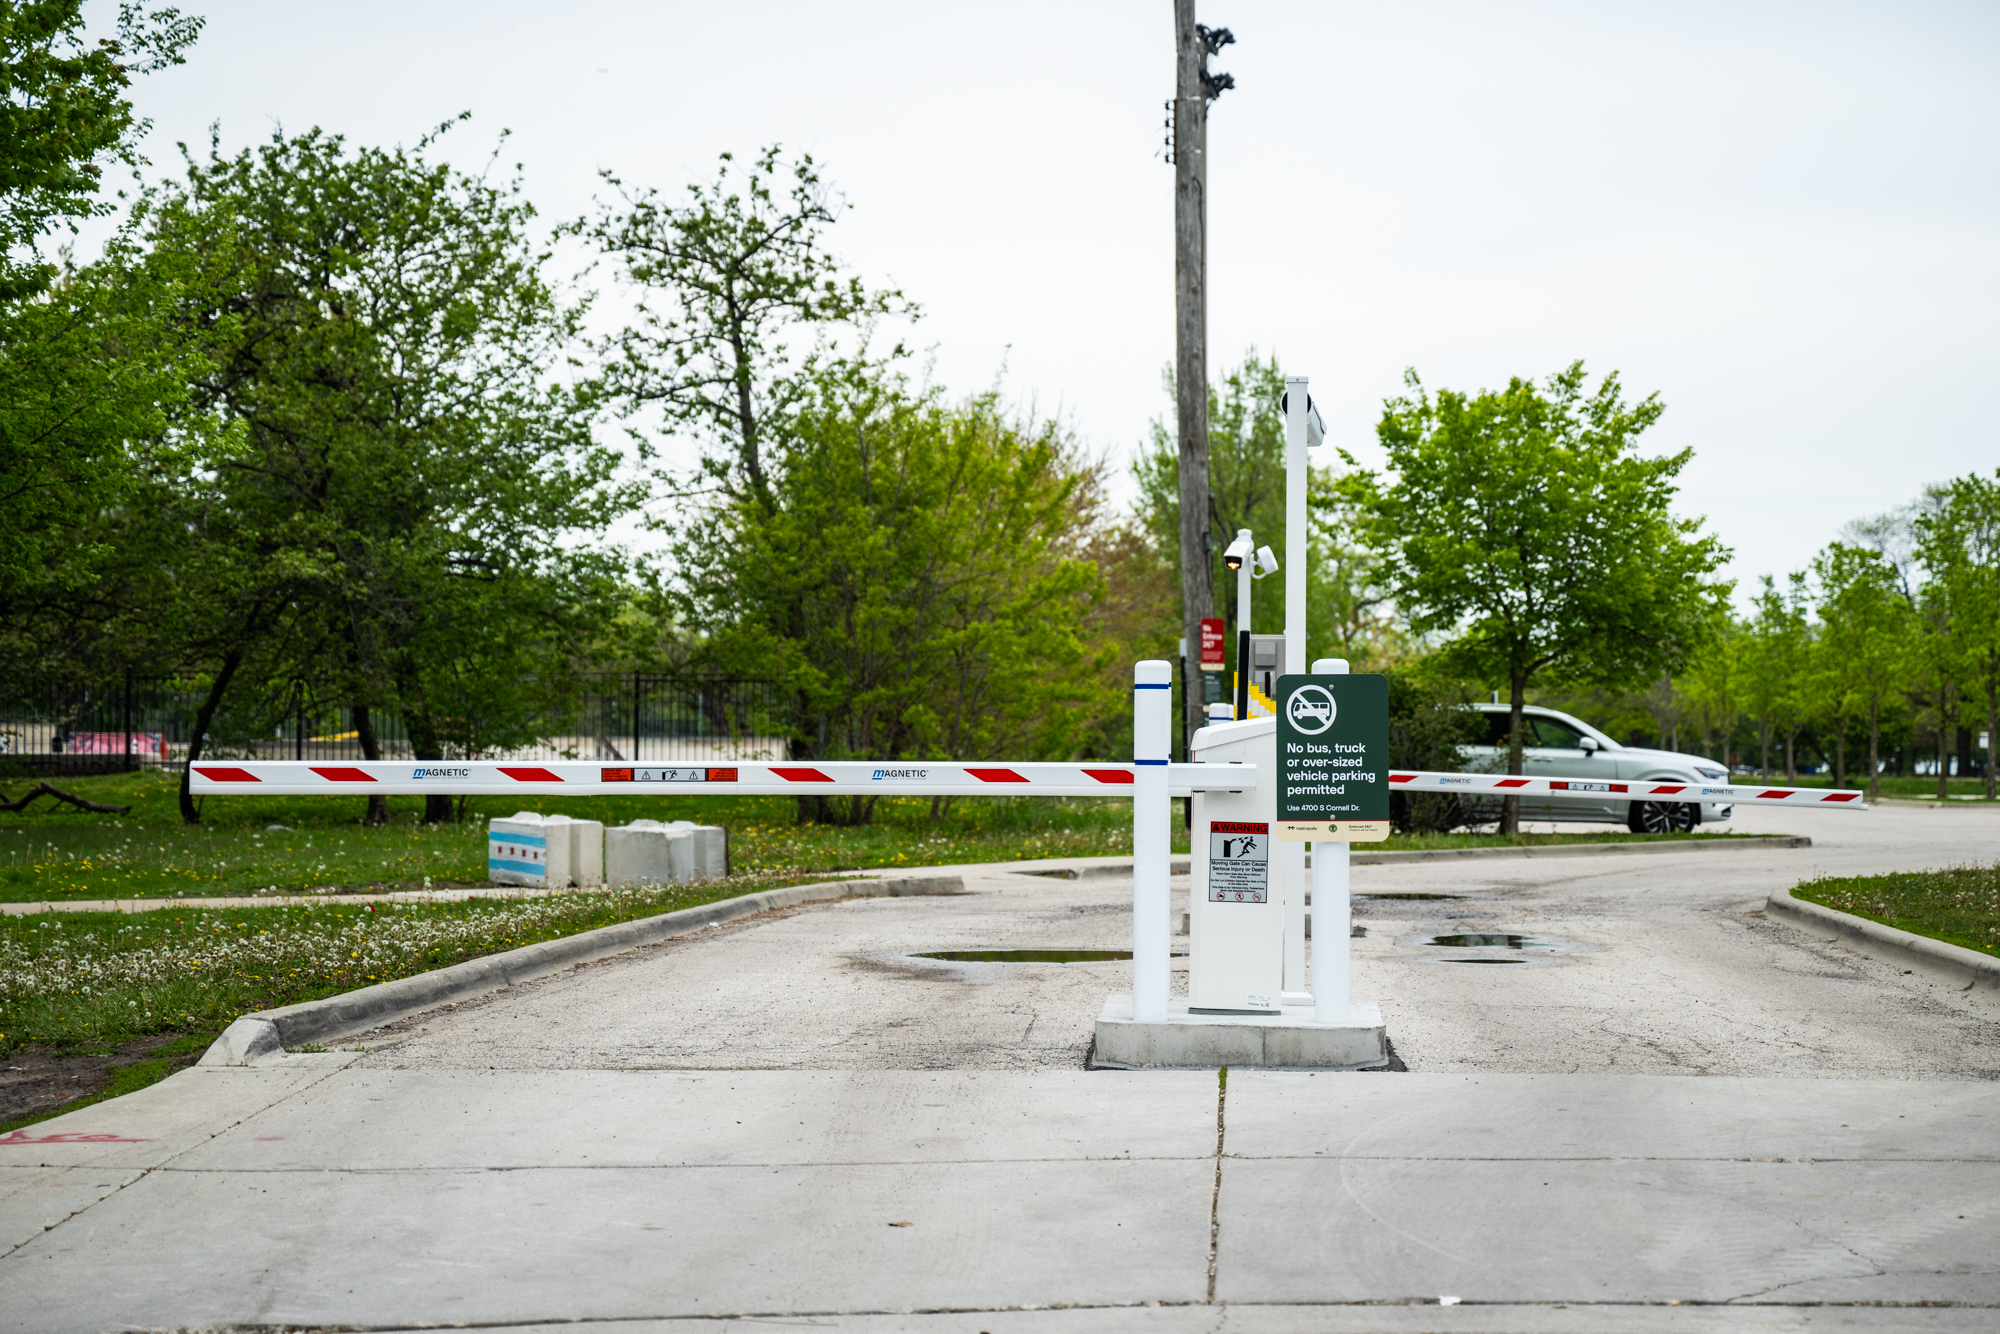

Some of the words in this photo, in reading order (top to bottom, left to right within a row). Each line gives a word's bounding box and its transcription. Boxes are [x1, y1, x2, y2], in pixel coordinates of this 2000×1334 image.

[1287, 742, 1304, 753] No
[1307, 742, 1332, 754] bus,
[1335, 742, 1366, 753] truck
[1287, 759, 1300, 767] or
[1302, 756, 1363, 767] over-sized
[1287, 770, 1329, 781] vehicle
[1332, 770, 1376, 784] parking
[1287, 784, 1345, 798] permitted
[1287, 804, 1300, 812] Use
[1301, 804, 1319, 812] 4700
[1320, 804, 1325, 812] S
[1326, 804, 1350, 812] Cornell
[1351, 804, 1361, 812] Dr.
[1221, 824, 1267, 832] WARNING
